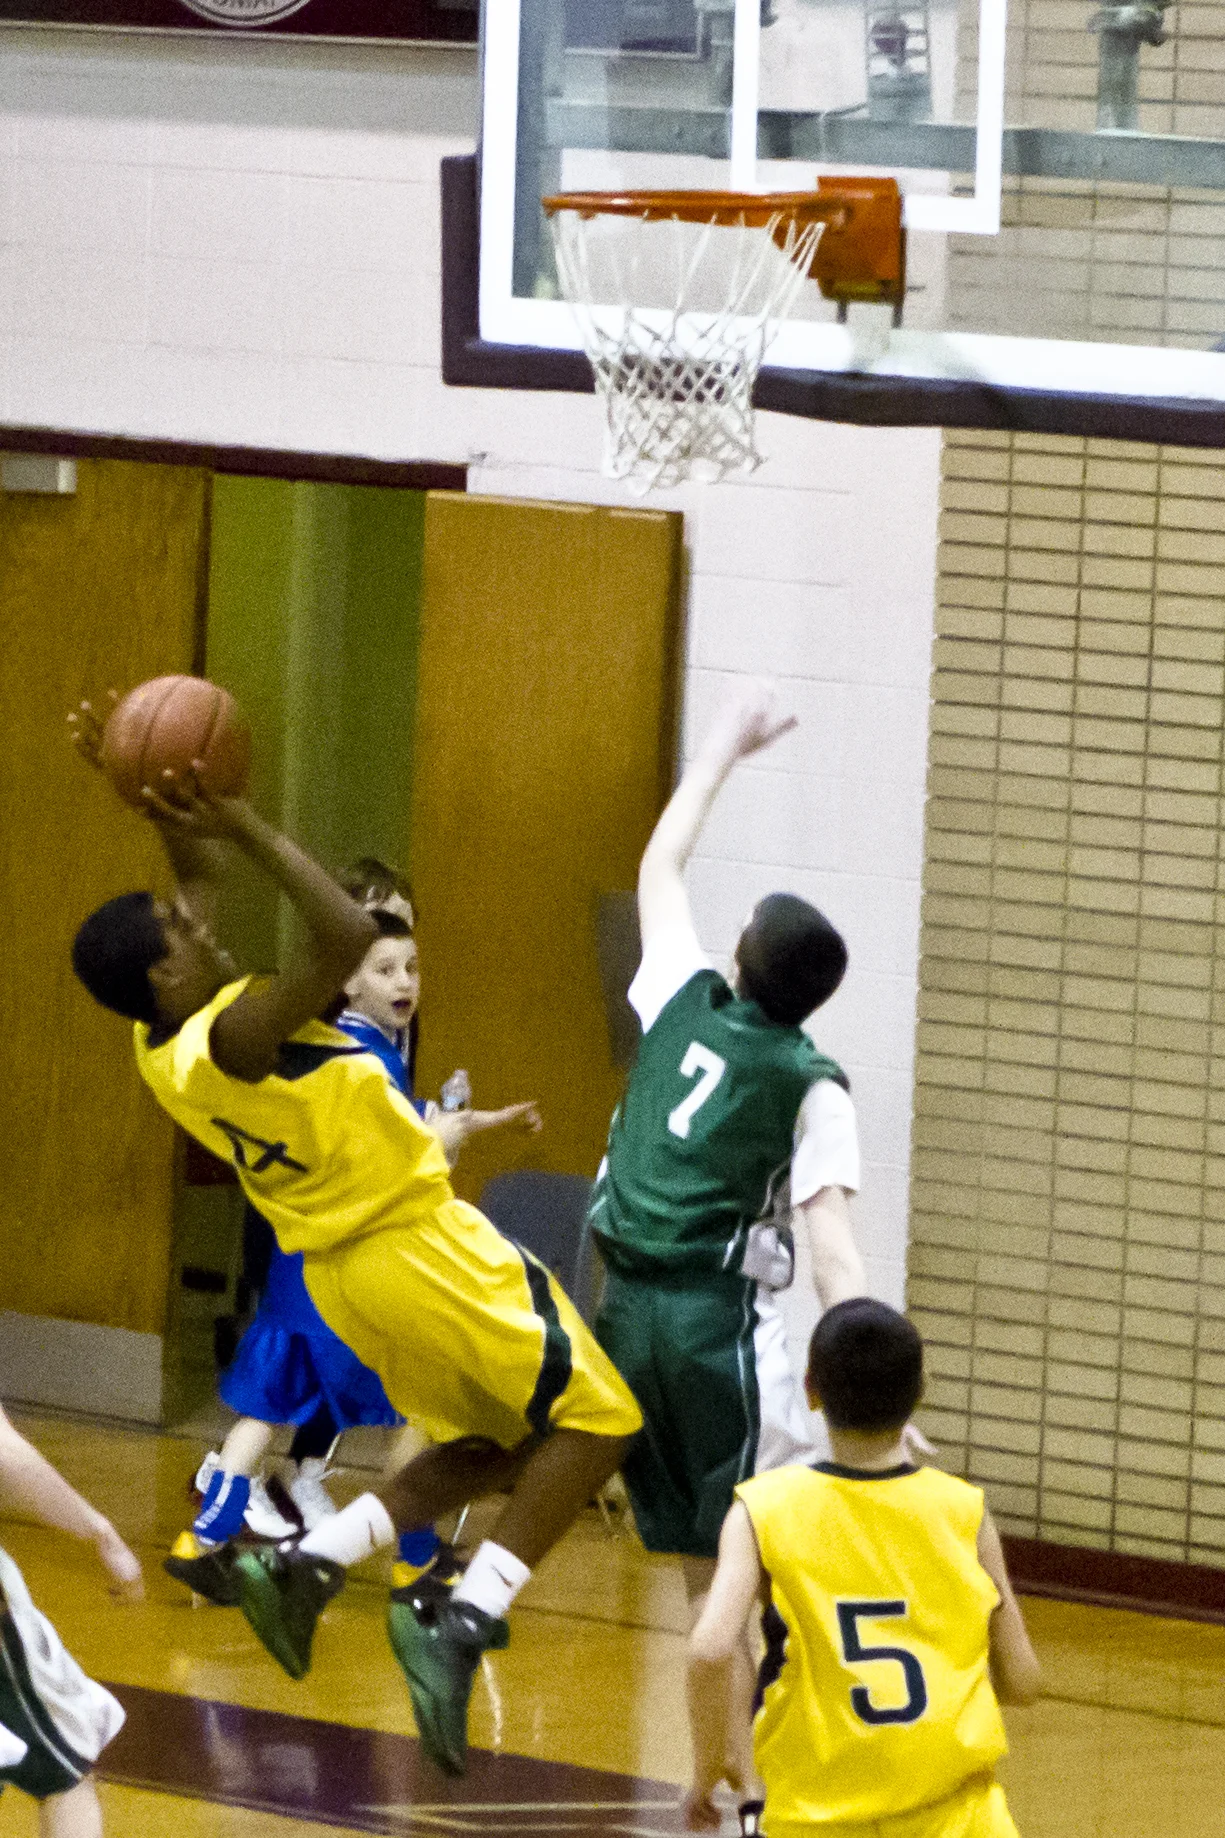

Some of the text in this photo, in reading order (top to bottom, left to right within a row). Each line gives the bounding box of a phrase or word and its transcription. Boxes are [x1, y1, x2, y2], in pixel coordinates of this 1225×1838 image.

[667, 1041, 727, 1140] 7
[210, 1117, 309, 1174] 4
[836, 1600, 928, 1725] 5
